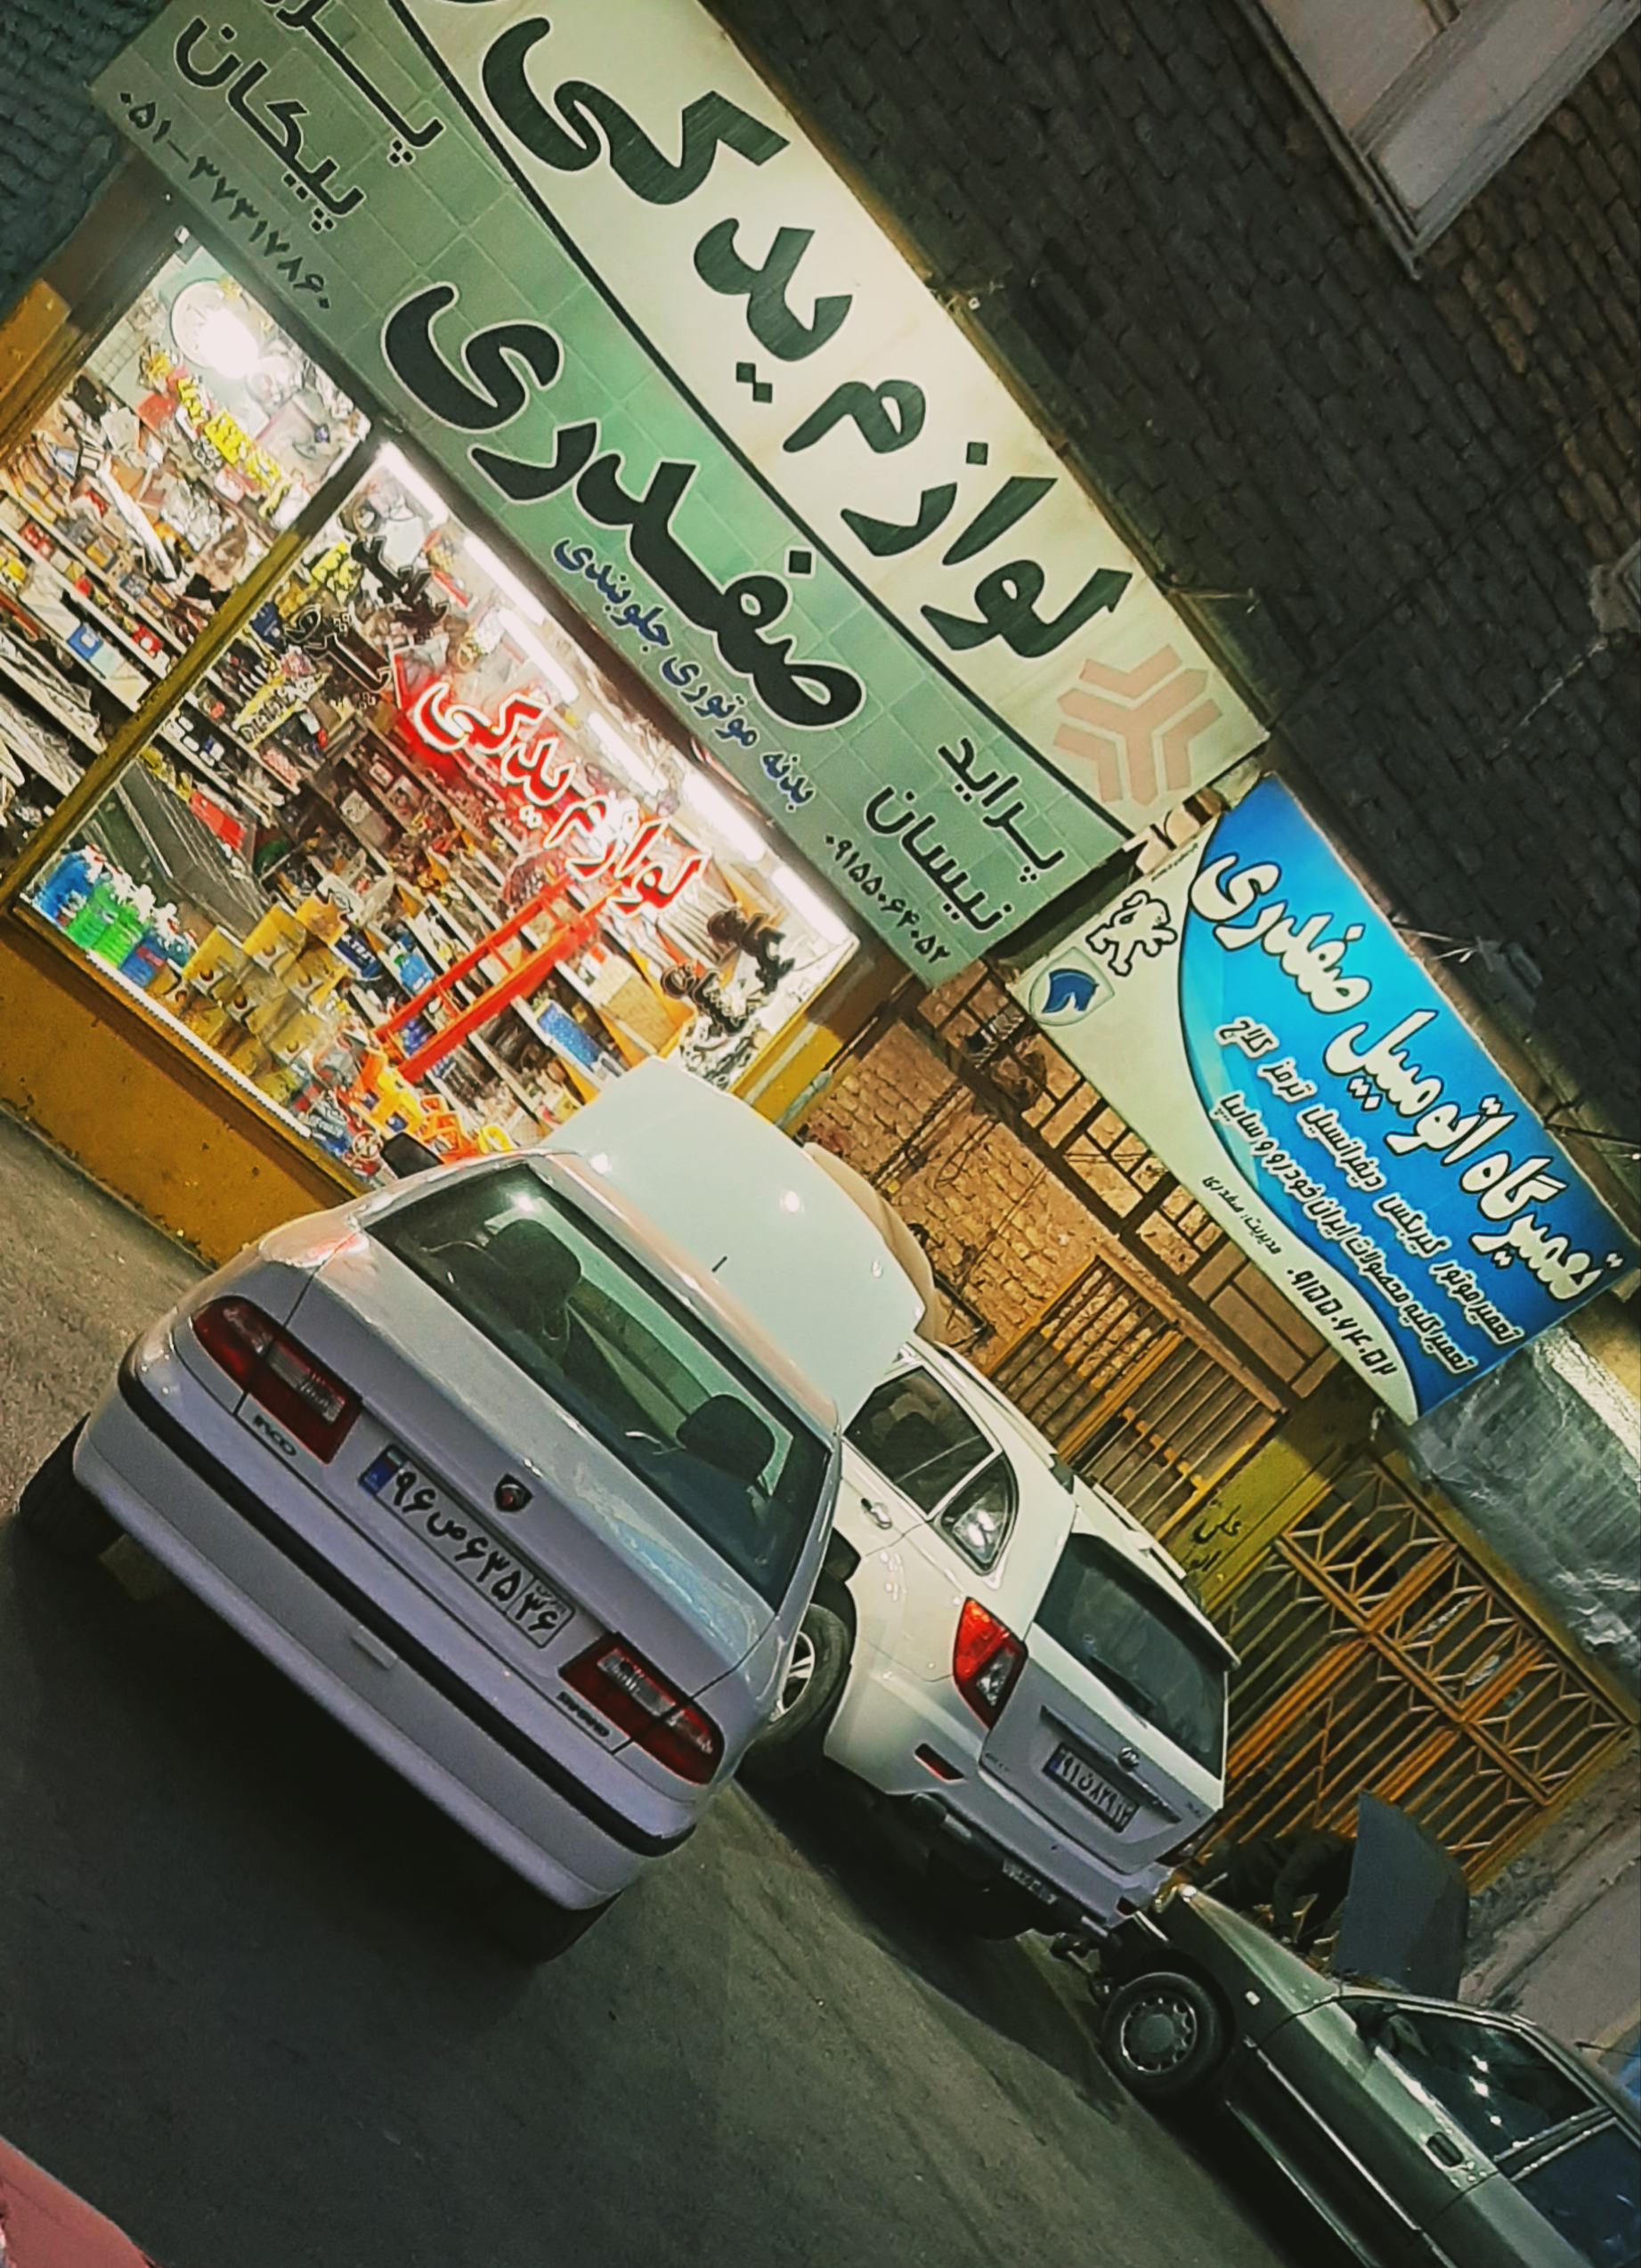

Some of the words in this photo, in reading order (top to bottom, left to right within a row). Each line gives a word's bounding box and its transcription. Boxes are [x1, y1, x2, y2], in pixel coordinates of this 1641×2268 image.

[175, 18, 366, 232] پیکان
[483, 18, 852, 405] یدکی
[383, 283, 864, 728] صفدری
[784, 379, 1132, 657] لوازم
[662, 653, 759, 749] موتوری
[413, 682, 577, 828] یدکی
[761, 751, 815, 811] بدنه
[936, 736, 1064, 883] پراید
[544, 795, 711, 918] لوازم
[865, 784, 1011, 931] نیسان
[826, 833, 950, 963] ۰۹۱۵۵۰۶۴۰۵۲
[1190, 853, 1372, 1013] صفدری
[1214, 1093, 1264, 1138] سایپا
[1262, 1061, 1312, 1098] ترمز
[1324, 1009, 1518, 1167] اتومبیل
[1254, 1140, 1275, 1152] و
[1265, 1153, 1321, 1199] خودرو
[1301, 1107, 1383, 1187] دیفرانسیل
[1202, 1175, 1245, 1213] صفدری
[1308, 1199, 1357, 1237] ایران
[1377, 1196, 1447, 1255] گیربکس
[1462, 1151, 1623, 1299] تعمیرگاه
[1345, 1237, 1408, 1302] محصولات
[1433, 1263, 1482, 1301] موتور
[1287, 1269, 1397, 1375] ۰۹۱۵۵۰۶۴۰۵۲
[1402, 1303, 1441, 1333] کلیه
[1425, 1333, 1475, 1370] تعمیر
[1467, 1303, 1521, 1342] تعمیر
[514, 1591, 559, 1632] ۳۶
